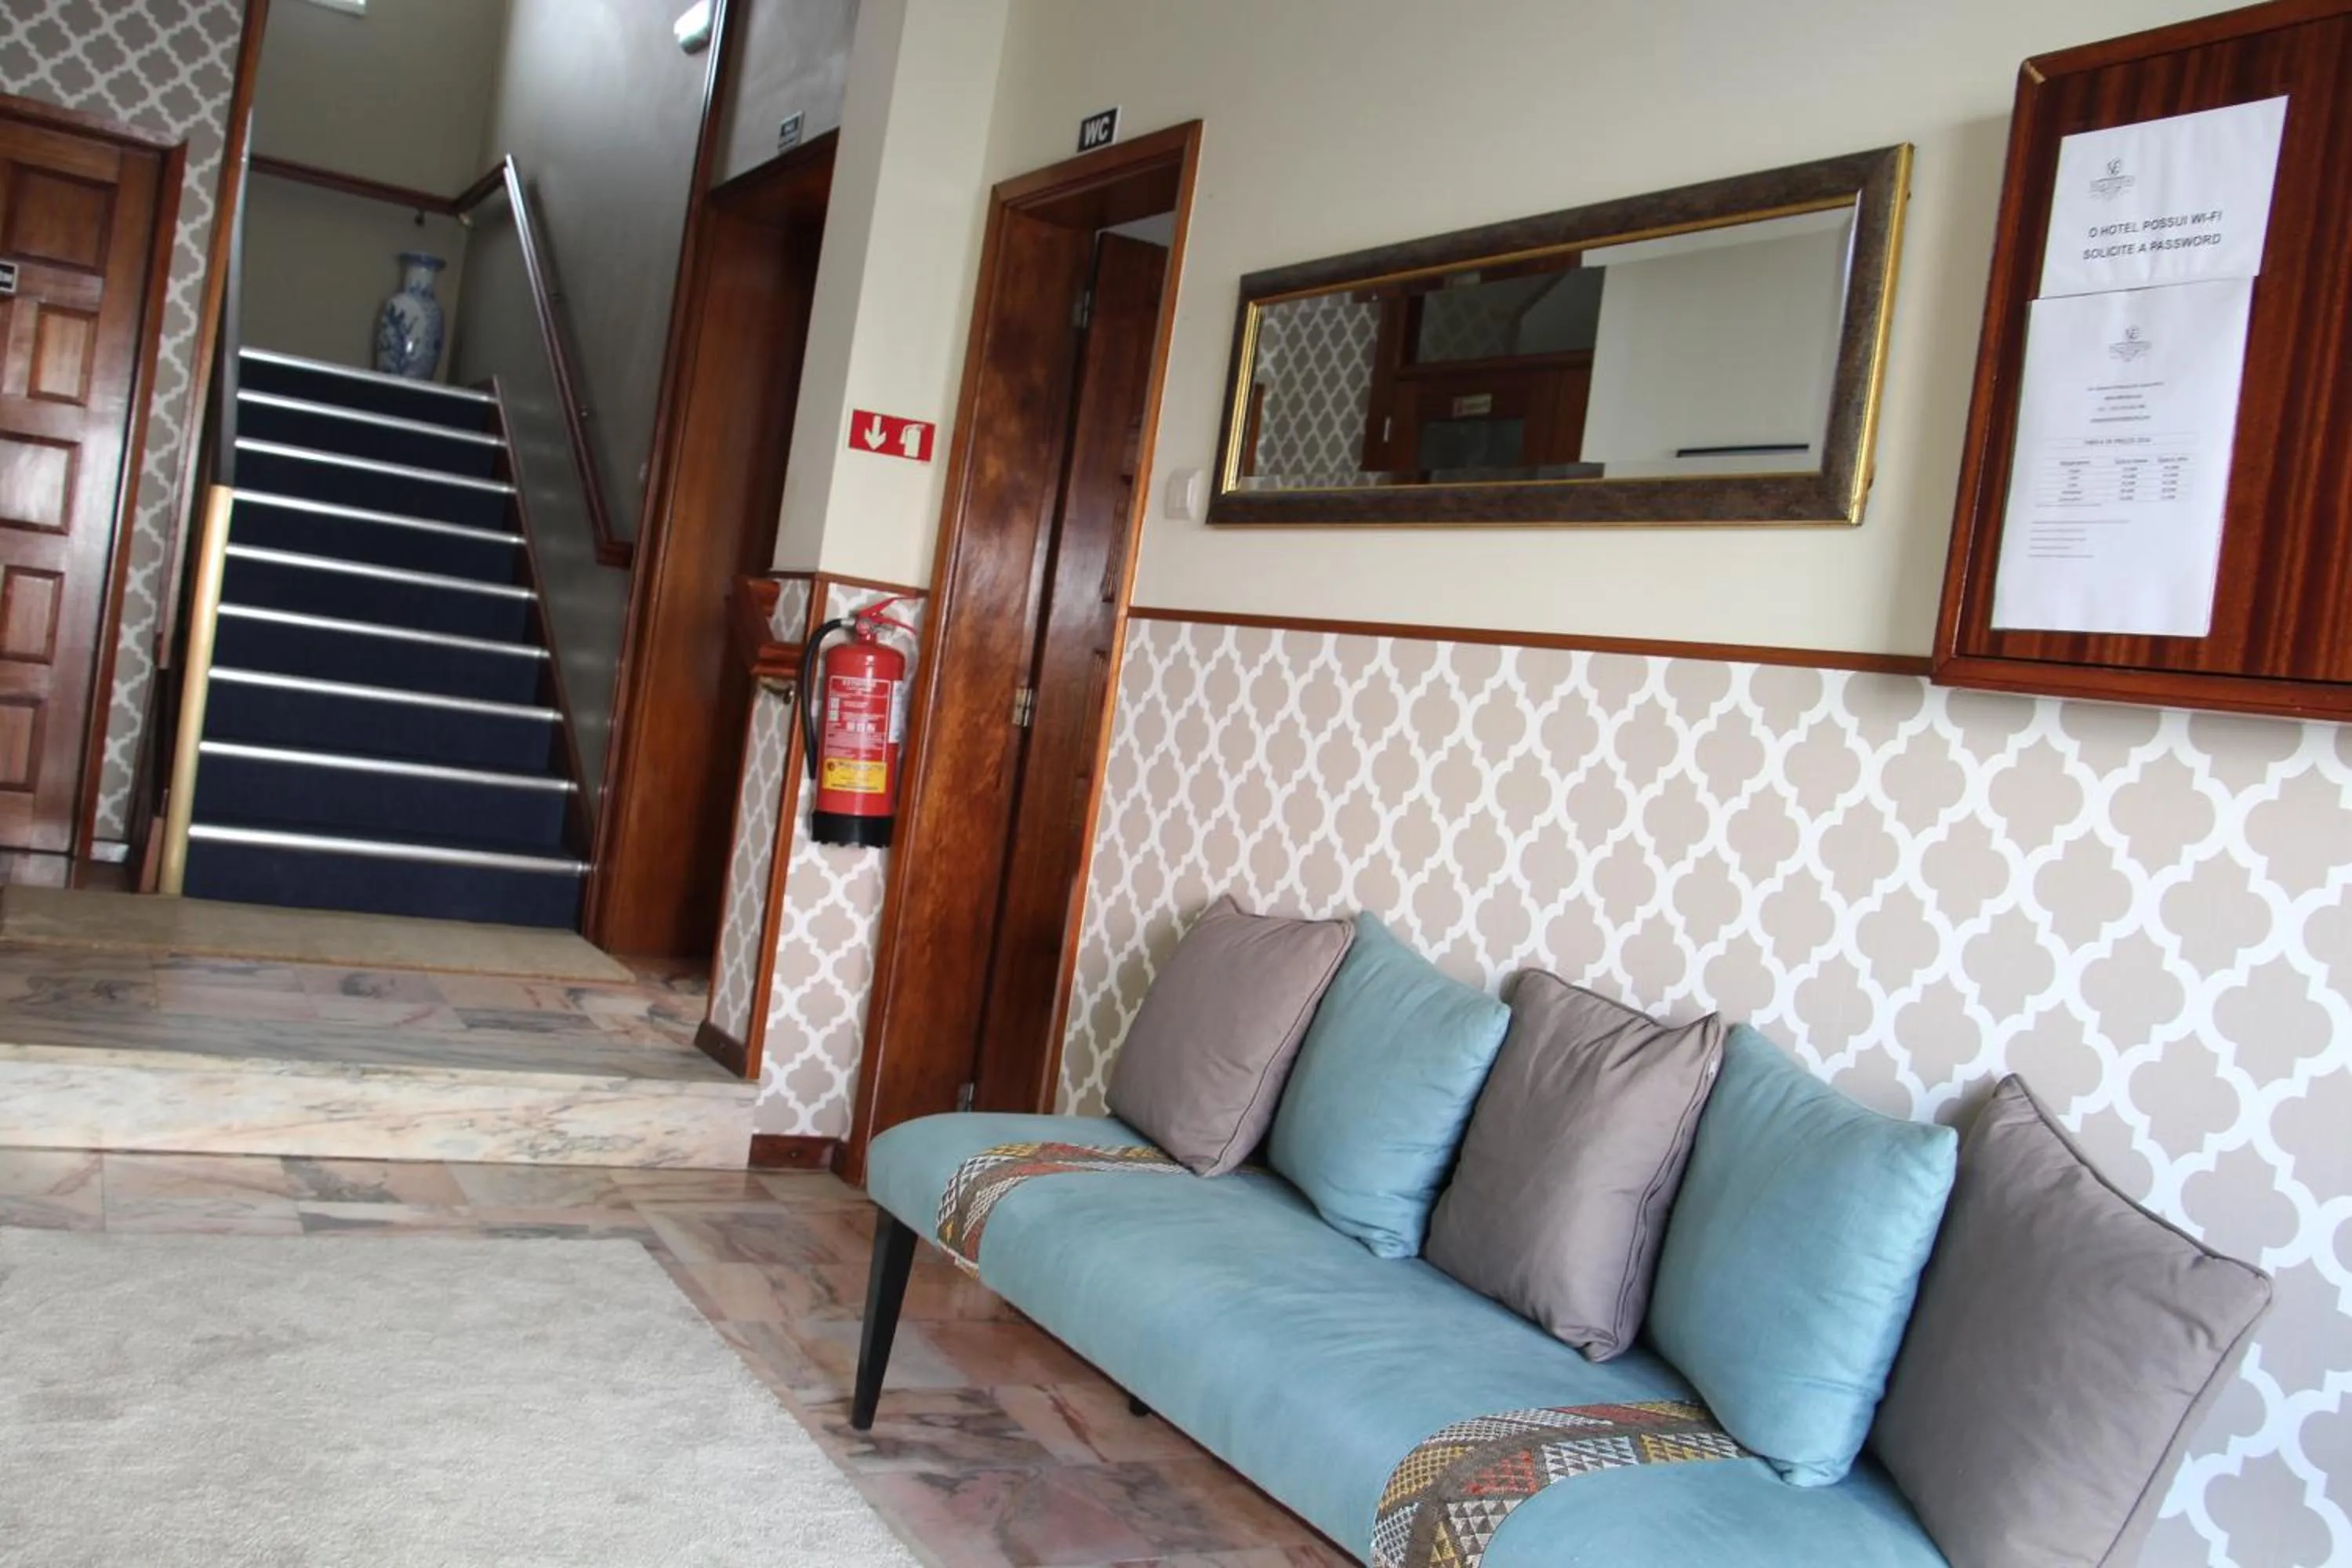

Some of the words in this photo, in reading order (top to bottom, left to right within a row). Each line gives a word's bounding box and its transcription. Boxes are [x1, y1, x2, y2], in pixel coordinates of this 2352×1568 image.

[1084, 116, 1110, 147] WC
[2089, 227, 2098, 238] O
[2100, 223, 2139, 236] HOTEL
[2143, 216, 2187, 230] POSSUI
[2190, 210, 2223, 224] WI-FI
[2082, 245, 2136, 260] SOLICITE
[2138, 243, 2147, 253] A
[2150, 234, 2221, 251] PASSWORD
